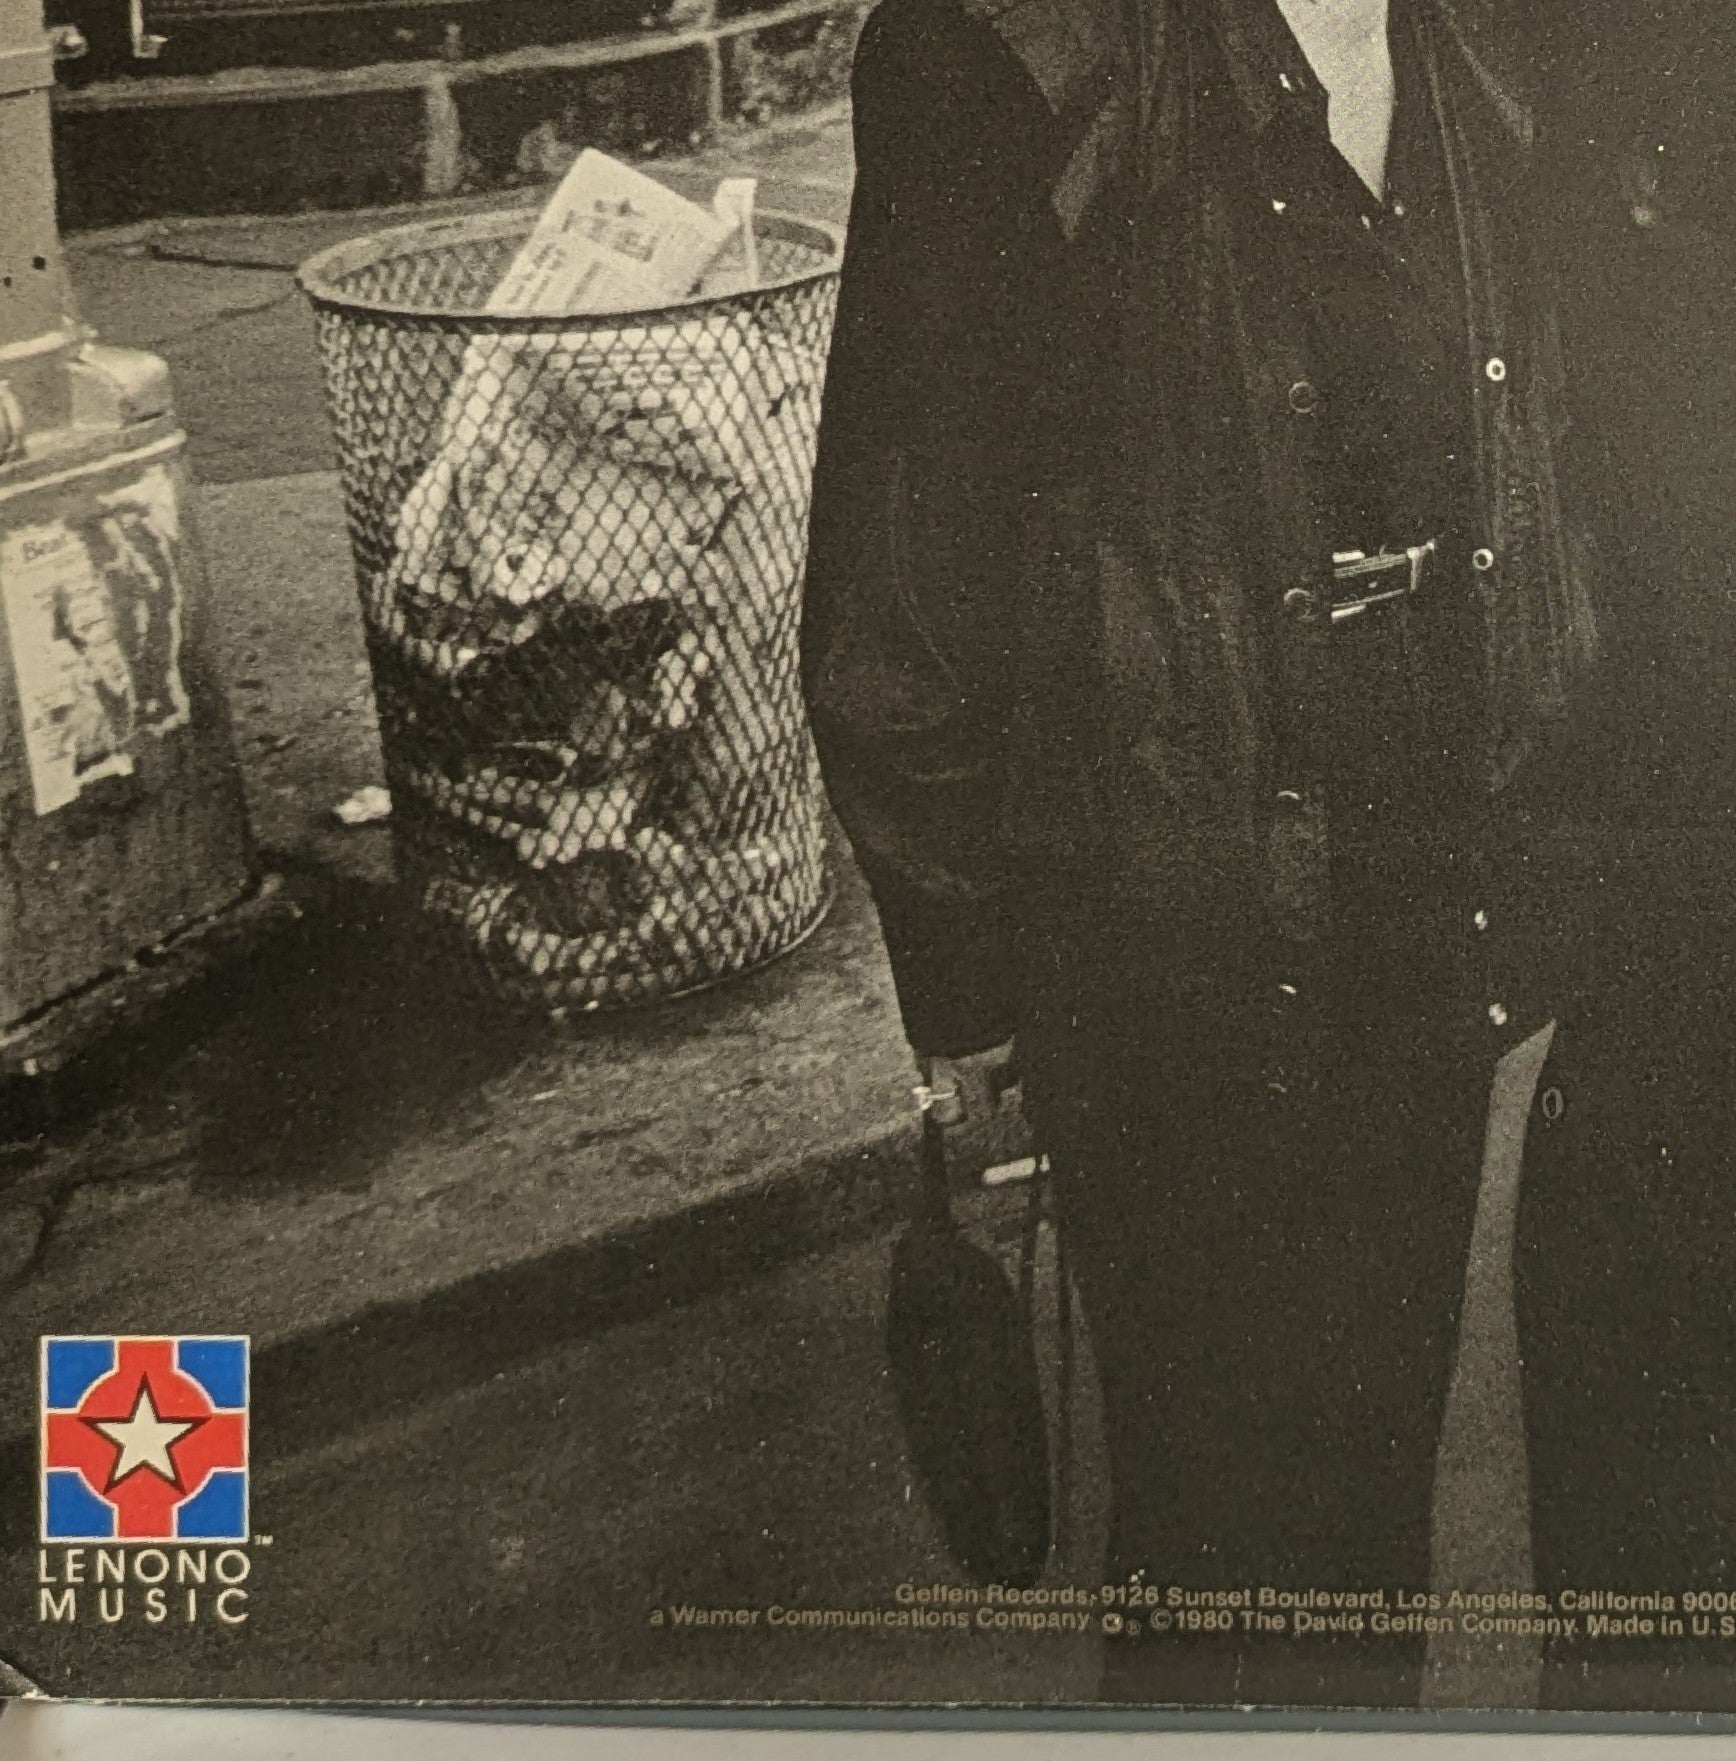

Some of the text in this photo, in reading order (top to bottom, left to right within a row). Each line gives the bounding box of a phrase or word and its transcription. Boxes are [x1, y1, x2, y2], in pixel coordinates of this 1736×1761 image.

[38, 1548, 251, 1584] LENONO
[38, 1587, 250, 1624] MUSIC
[895, 1583, 978, 1604] Geffen
[1101, 1585, 1159, 1606] 9126
[1166, 1586, 1252, 1607] Sunset
[1258, 1587, 1391, 1610] Boulevard,
[1397, 1589, 1441, 1610] Los
[1448, 1589, 1553, 1614] Angeles,
[1560, 1589, 1675, 1611] California
[650, 1609, 663, 1626] a
[670, 1604, 761, 1626] Warner
[767, 1605, 969, 1628] Communications
[976, 1607, 1090, 1632] Company
[1241, 1610, 1286, 1631] The
[1293, 1611, 1364, 1633] David
[1371, 1612, 1455, 1634] Geffen
[1586, 1614, 1654, 1636] Made
[1661, 1614, 1683, 1636] in
